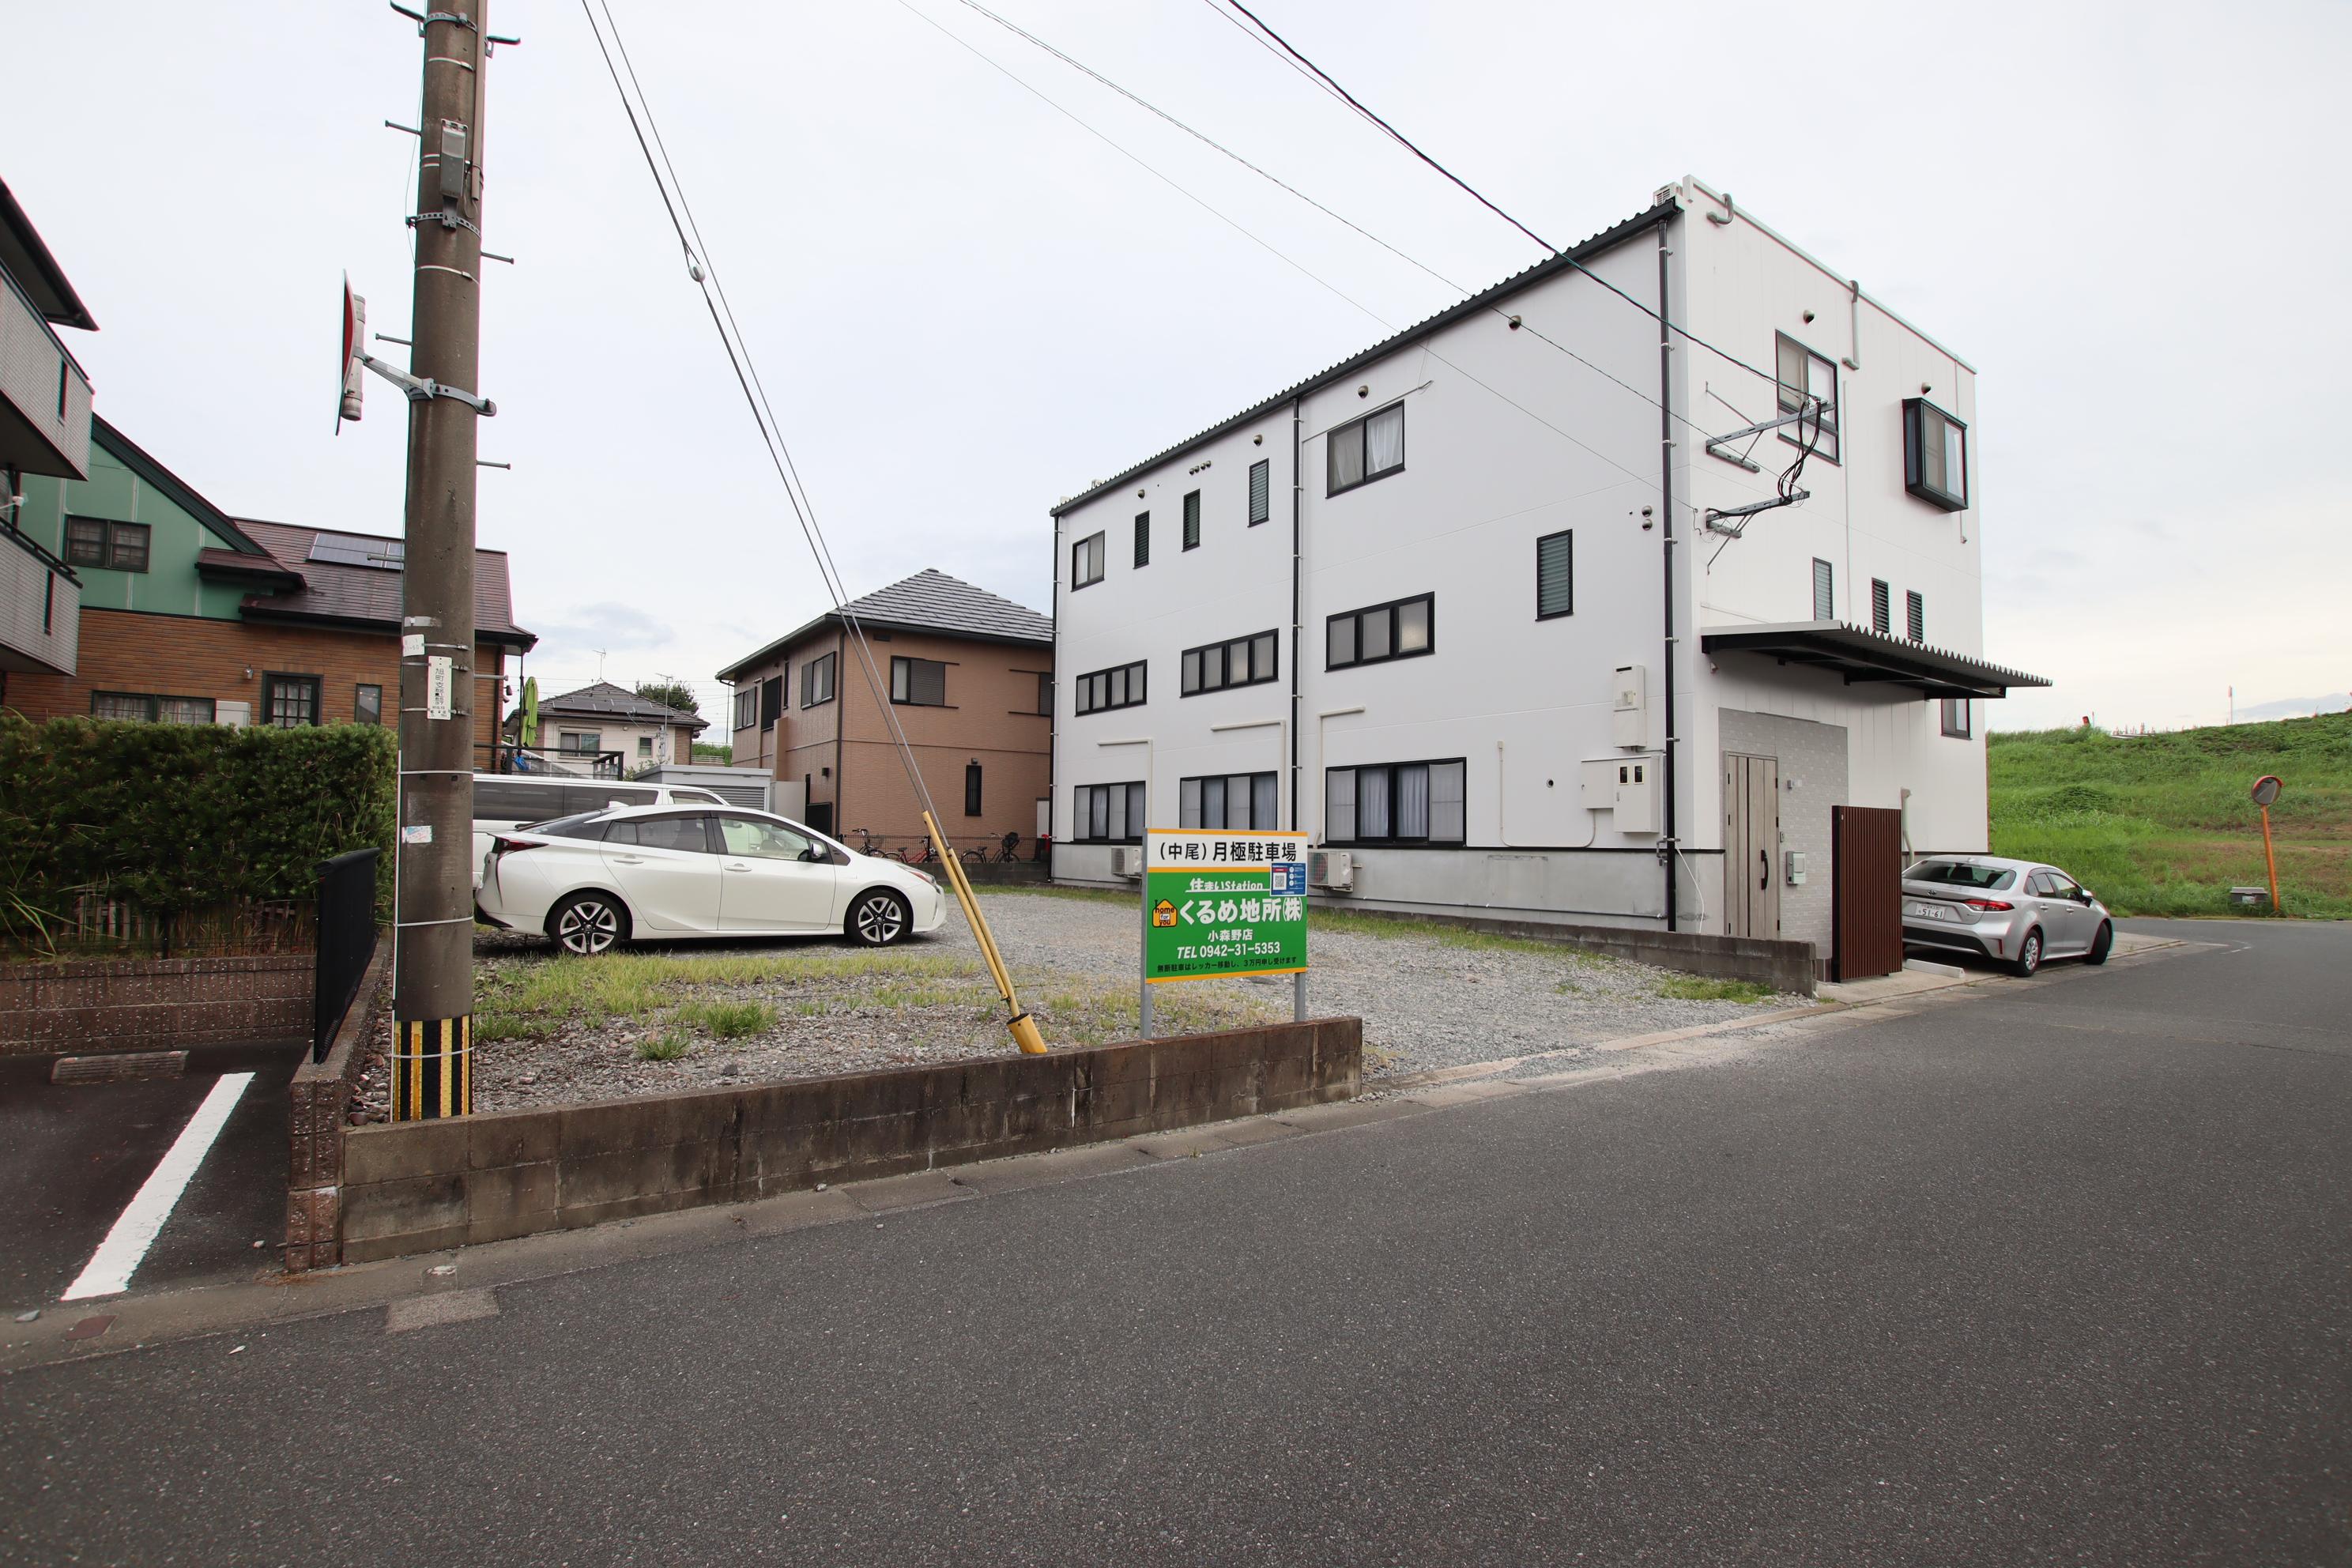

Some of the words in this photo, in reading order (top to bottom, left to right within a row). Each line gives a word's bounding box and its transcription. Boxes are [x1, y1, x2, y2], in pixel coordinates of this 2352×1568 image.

[1189, 879, 1263, 891] 住まいStation
[1208, 929, 1253, 942] 小森野店
[1177, 946, 1197, 959] TEL
[1200, 941, 1280, 958] 0942-31-5353
